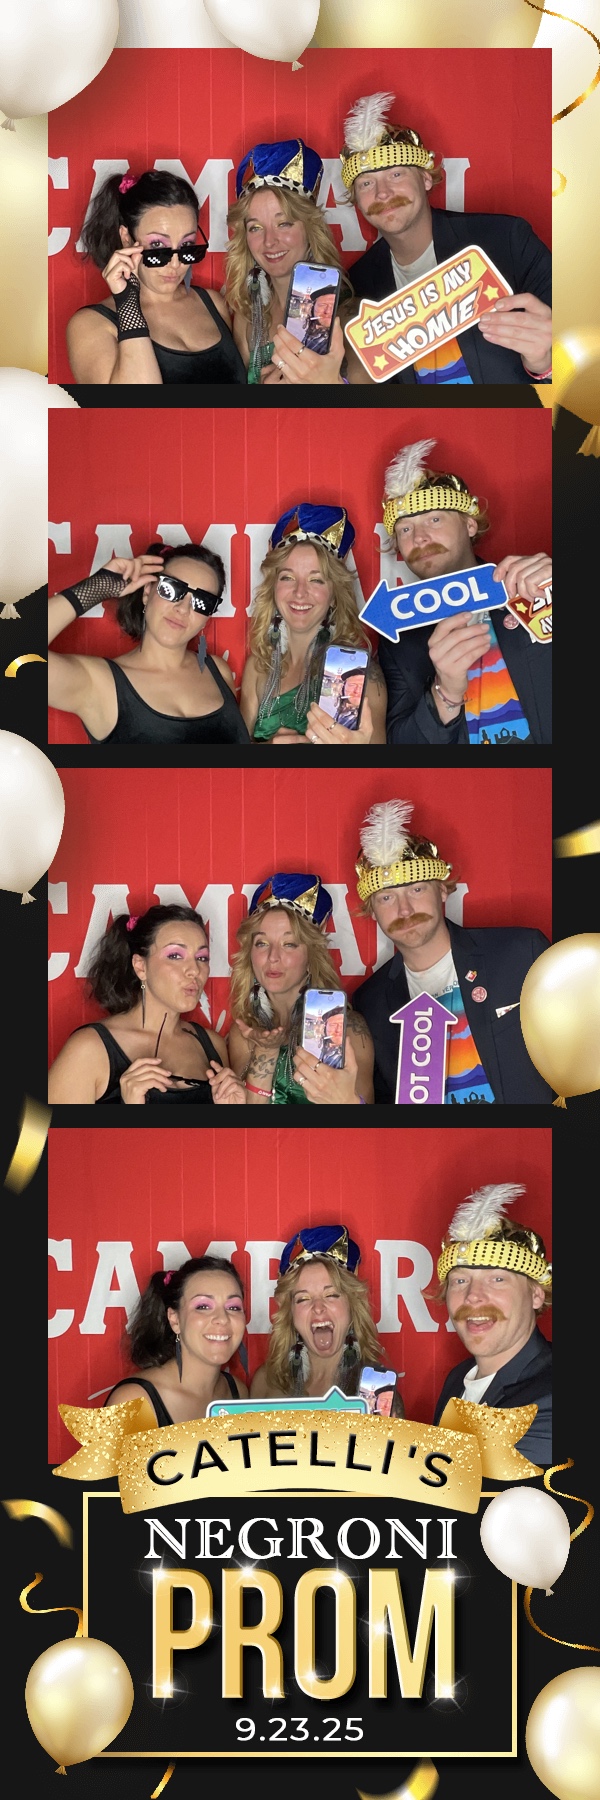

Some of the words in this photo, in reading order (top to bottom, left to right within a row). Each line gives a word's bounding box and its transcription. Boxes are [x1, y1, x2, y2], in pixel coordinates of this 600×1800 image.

[363, 295, 417, 344] JESUS
[419, 281, 439, 308] IS
[442, 260, 472, 295] MY
[387, 288, 479, 361] HOMIE
[390, 576, 489, 620] COOL
[411, 1007, 433, 1067] COOL
